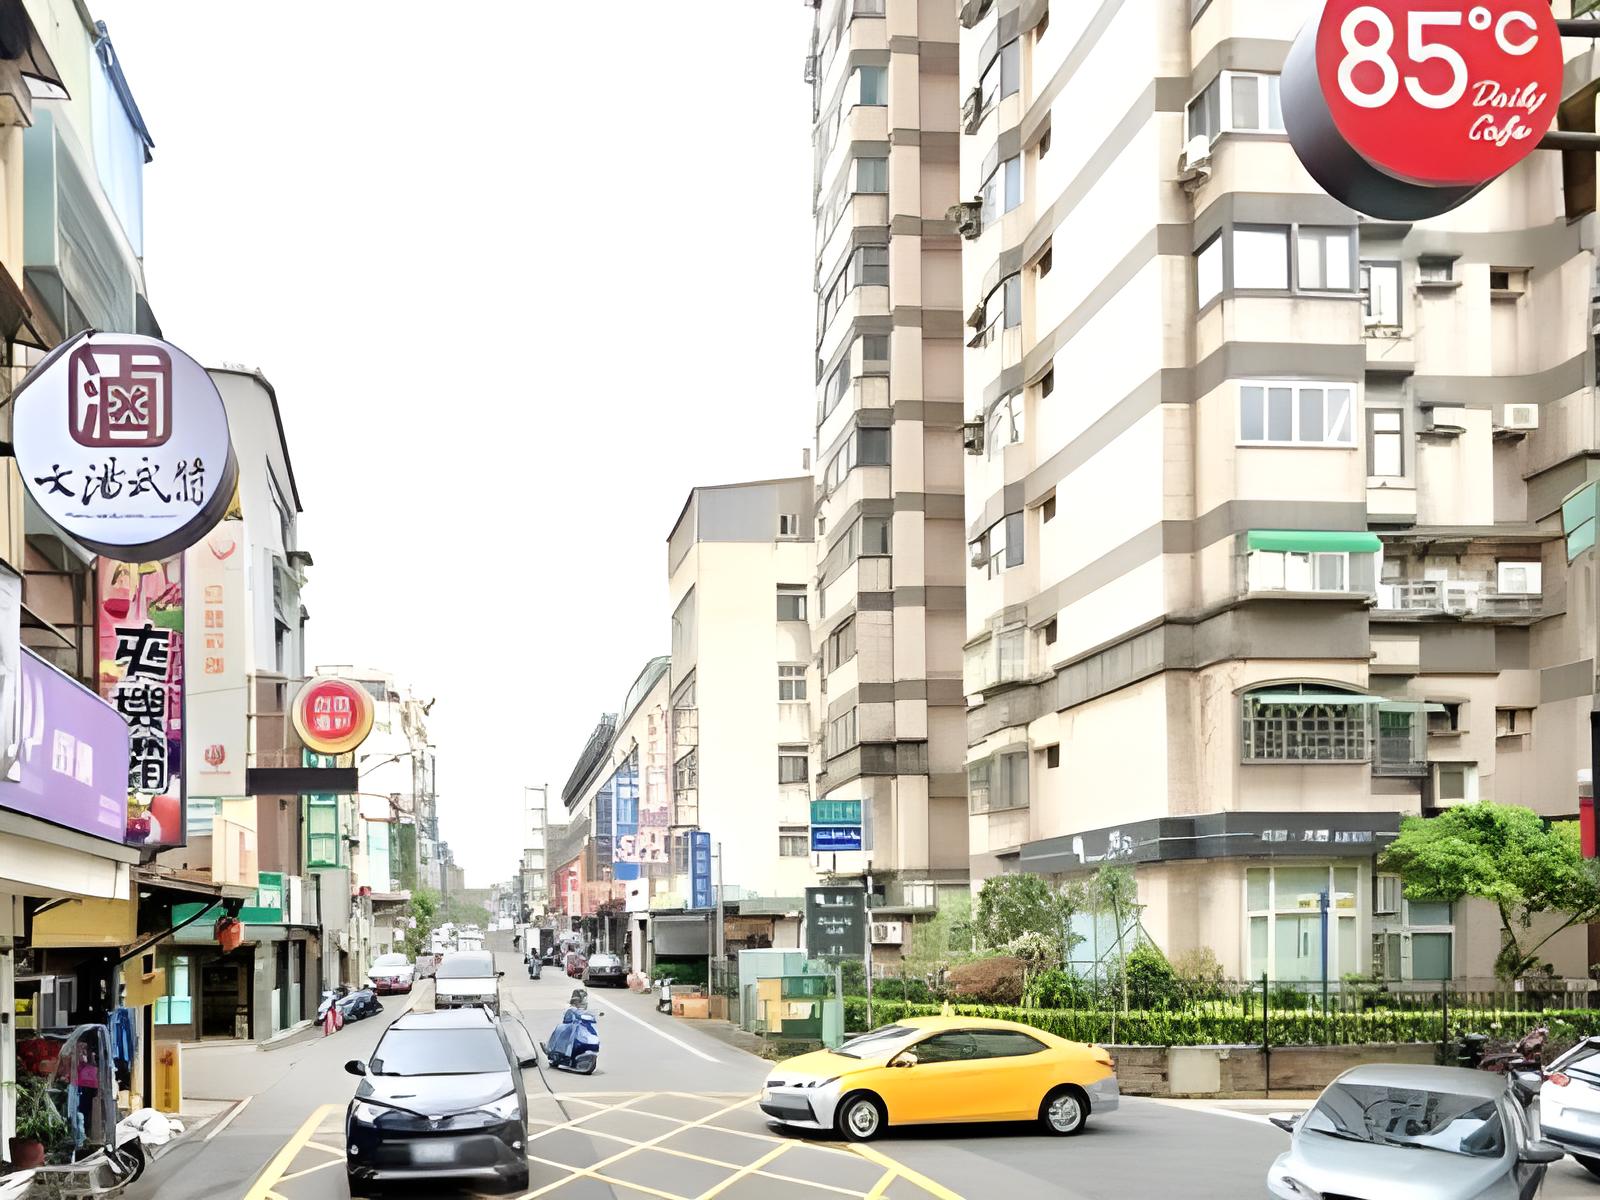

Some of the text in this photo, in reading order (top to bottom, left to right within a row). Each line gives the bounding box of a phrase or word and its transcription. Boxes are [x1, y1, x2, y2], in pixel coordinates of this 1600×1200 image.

[1337, 6, 1539, 109] 85°C
[1472, 80, 1547, 115] Daily
[1468, 114, 1532, 147] Cafe
